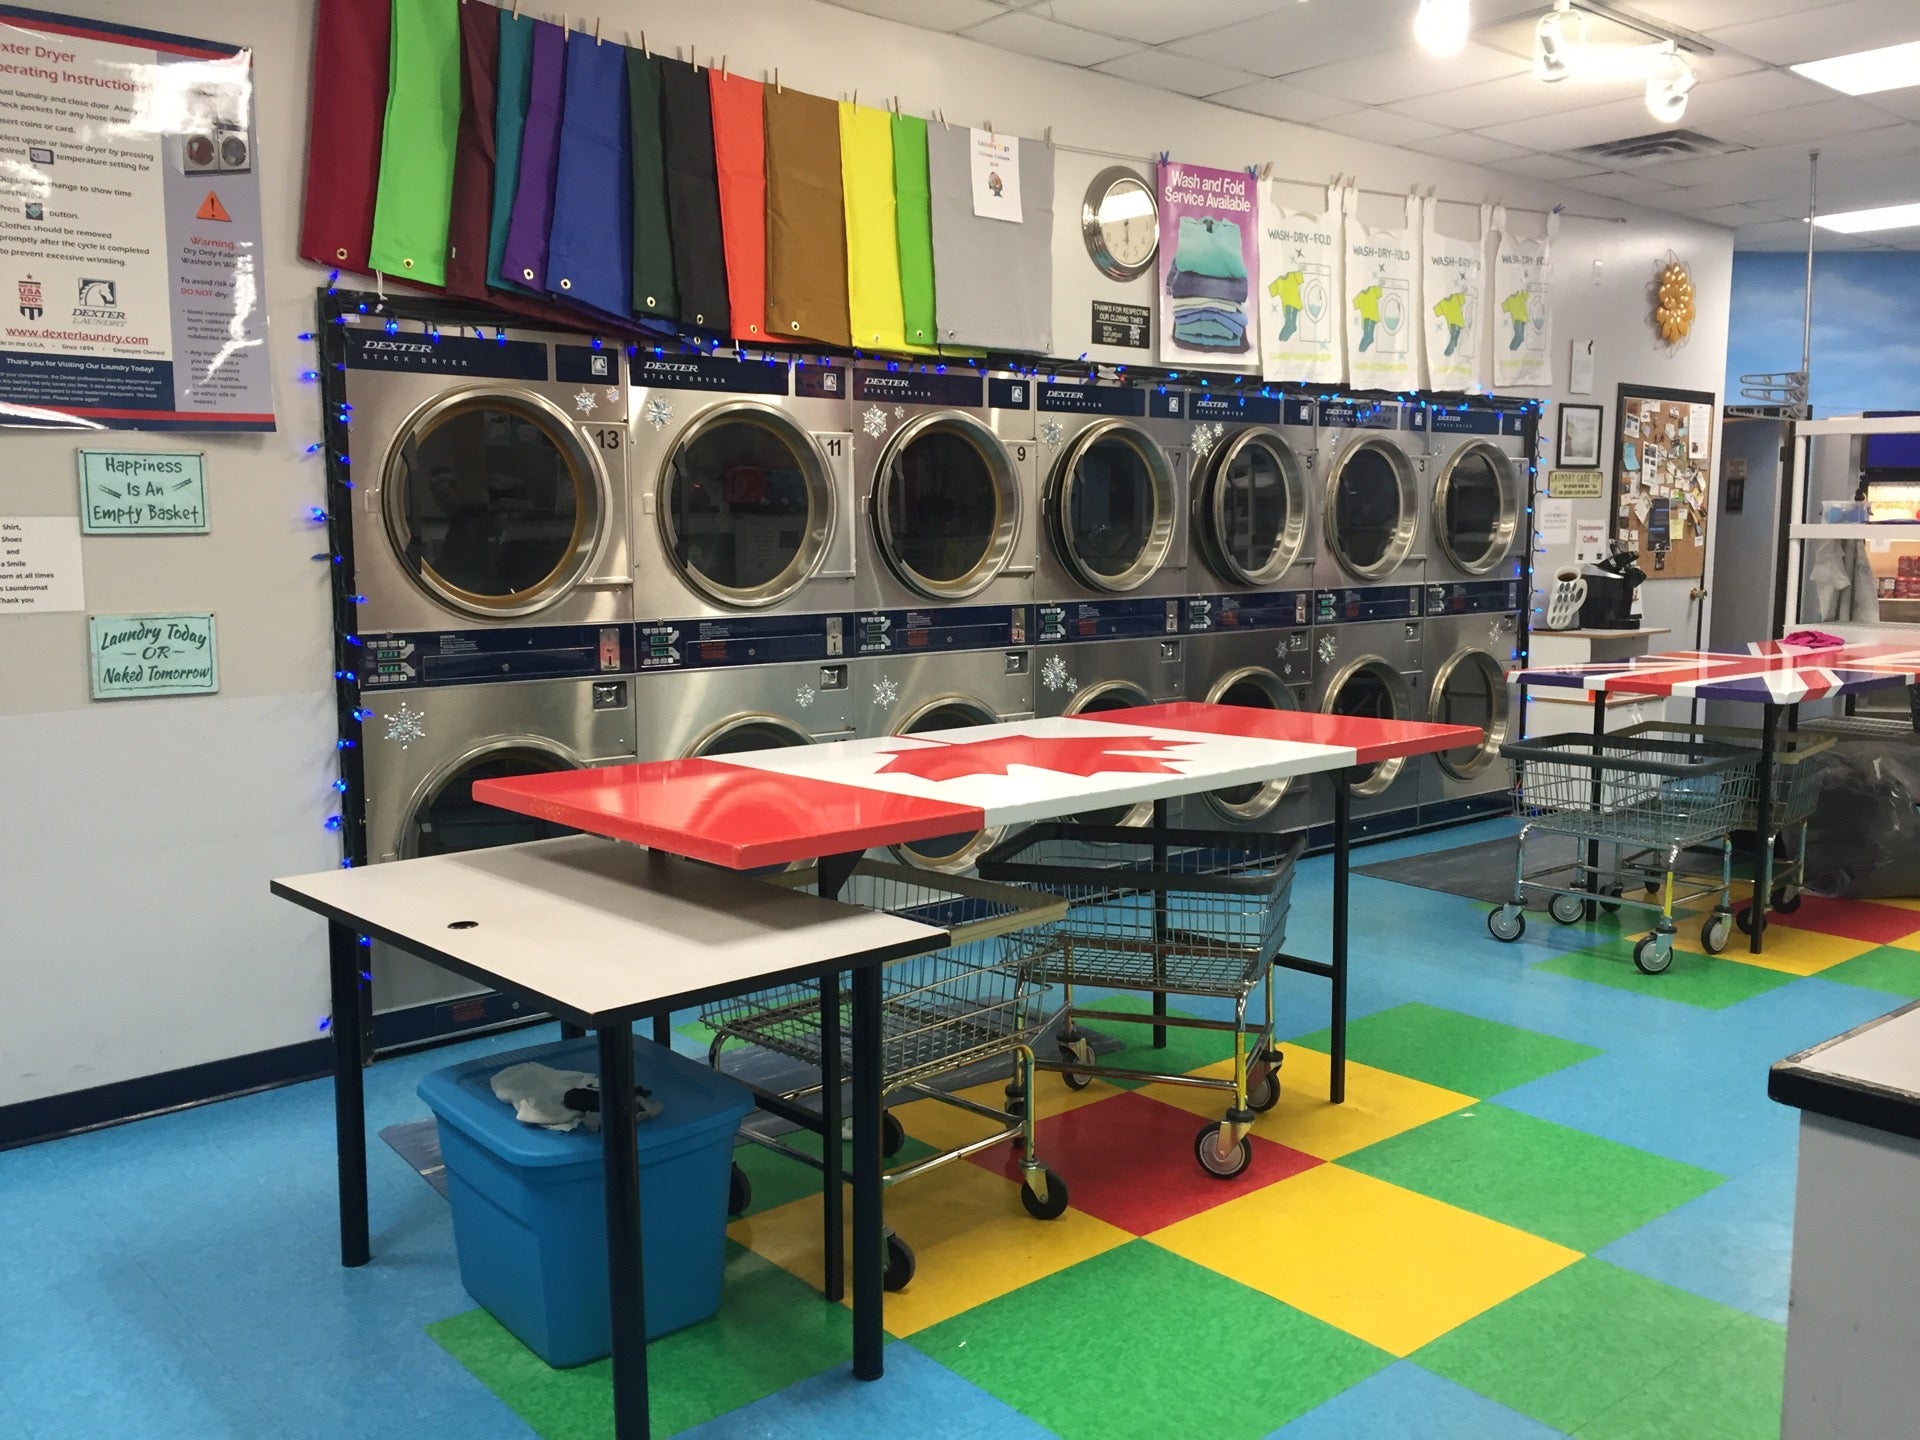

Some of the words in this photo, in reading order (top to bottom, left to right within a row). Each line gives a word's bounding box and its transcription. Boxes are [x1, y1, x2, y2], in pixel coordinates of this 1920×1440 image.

[35, 46, 76, 63] Dryer
[15, 90, 48, 102] laundry
[50, 96, 66, 104] and
[67, 98, 89, 107] close
[20, 104, 53, 114] pockets
[55, 107, 67, 116] for
[69, 112, 84, 120] any
[86, 113, 108, 123] loose
[20, 120, 42, 130] coins
[44, 123, 53, 131] or
[22, 136, 47, 147] upper
[60, 142, 83, 151] lower
[85, 145, 107, 156] dryer
[108, 148, 119, 158] by
[120, 151, 154, 162] pressing
[56, 153, 110, 167] temperature
[109, 161, 137, 172] setting
[138, 163, 150, 172] for
[1171, 170, 1200, 189] Wash
[1202, 177, 1222, 193] and
[1223, 178, 1245, 196] Fold
[80, 184, 89, 193] to
[91, 187, 112, 195] show
[114, 189, 133, 198] time
[1164, 186, 1204, 206] Service
[1206, 192, 1251, 212] Available
[33, 225, 62, 235] should
[64, 227, 75, 236] be
[76, 229, 112, 239] removed
[1268, 229, 1332, 246] WASH-DRY-FOLD
[0, 235, 38, 246] promptly
[40, 237, 59, 247] after
[62, 239, 76, 248] the
[77, 241, 98, 251] cycle
[107, 245, 150, 256] completed
[11, 248, 44, 259] prevent
[46, 252, 85, 263] excessive
[183, 247, 198, 257] Dry
[199, 249, 217, 259] Only
[1353, 245, 1410, 261] WASH-DRY-FOLD
[181, 257, 212, 267] Washed
[181, 276, 190, 284] To
[191, 279, 213, 287] avoid
[214, 280, 227, 288] risk
[18, 288, 42, 296] USA
[181, 288, 194, 296] DO
[195, 289, 213, 297] NOT
[72, 308, 126, 320] DEXTER
[1099, 312, 1109, 320] OUR
[1110, 314, 1129, 322] CLOSING
[1112, 305, 1122, 313] FOR
[1122, 306, 1149, 316] RESPECTING
[72, 317, 128, 328] LAUNDRY
[5, 327, 149, 345] www.dexterlaundry.com
[363, 340, 432, 353] DEXTER
[6, 357, 29, 366] Thank
[30, 360, 44, 368] you
[57, 361, 85, 370] Visiting
[101, 363, 129, 373] Laundry
[131, 365, 155, 375] Today!
[363, 353, 409, 362] STACK
[421, 357, 467, 366] DRYER
[644, 361, 699, 372] DEXTER
[643, 373, 680, 381] STACK
[689, 375, 726, 384] DRYER
[864, 377, 910, 387] DEXTER
[1046, 390, 1084, 399] DEXTER
[1197, 400, 1229, 408] DEXTER
[595, 430, 619, 449] 13
[827, 439, 841, 456] 11
[1017, 446, 1026, 462] 9
[105, 456, 183, 476] Happiness
[1175, 452, 1181, 467] 7
[1306, 456, 1312, 470] 5
[1419, 459, 1425, 472] 3
[127, 481, 140, 497] Is
[145, 481, 164, 497] An
[93, 505, 143, 525] Empty
[148, 503, 199, 525] Basket
[2, 523, 22, 531] Shirt,
[1583, 535, 1598, 543] Coffee
[5, 584, 48, 592] Laundromat
[20, 597, 35, 605] you
[101, 622, 162, 650] Laundry
[167, 623, 207, 650] Today
[142, 646, 171, 660] OR
[103, 665, 143, 685] Naked
[148, 664, 210, 684] Tomorrow
